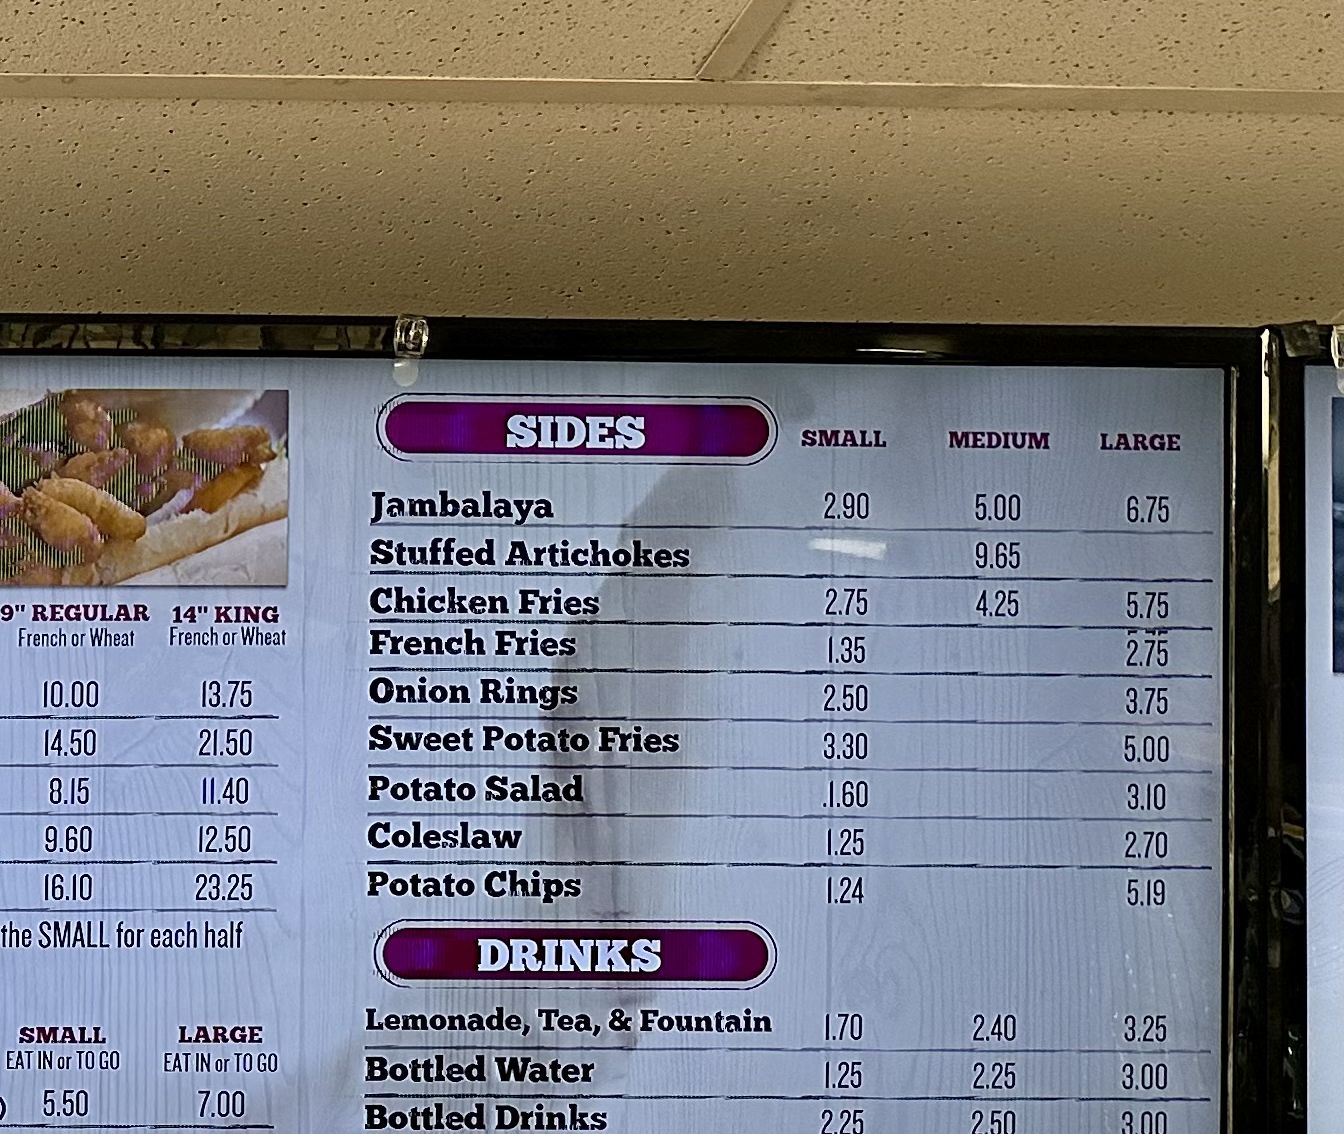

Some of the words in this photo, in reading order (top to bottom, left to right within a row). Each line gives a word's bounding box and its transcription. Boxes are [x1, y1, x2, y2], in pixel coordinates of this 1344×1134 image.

[506, 414, 646, 449] SIDES
[801, 429, 887, 448] SMALL
[948, 431, 1050, 450] MEDIUM
[1100, 433, 1181, 452] LARGE
[369, 490, 554, 526] Jambalaya
[824, 492, 869, 520] 2.90
[975, 493, 1021, 521] 5.00
[1127, 495, 1170, 523] 6.75
[49, 777, 90, 805] 8.15
[202, 777, 249, 805] 11.40
[0, 920, 32, 948] the
[38, 920, 111, 949] SMALL
[116, 920, 145, 949] for
[150, 920, 198, 949] each
[204, 920, 244, 949] half
[477, 938, 662, 973] DRINKS
[18, 1026, 107, 1044] SMALL
[178, 1025, 263, 1044] LARGE
[365, 1006, 531, 1037] Lemonade,
[537, 1008, 601, 1037] Tea,
[608, 1008, 633, 1032] &
[639, 1008, 773, 1033] Fountain
[825, 1013, 863, 1041] 1.70
[972, 1014, 1017, 1042] 2.40
[1124, 1015, 1167, 1043] 3.25
[6, 1050, 35, 1070] EAT
[37, 1050, 53, 1070] IN
[57, 1056, 73, 1070] or
[75, 1050, 95, 1070] TO
[99, 1050, 120, 1070] GO
[43, 1089, 89, 1117] 5.50
[197, 1090, 245, 1118] 7.00
